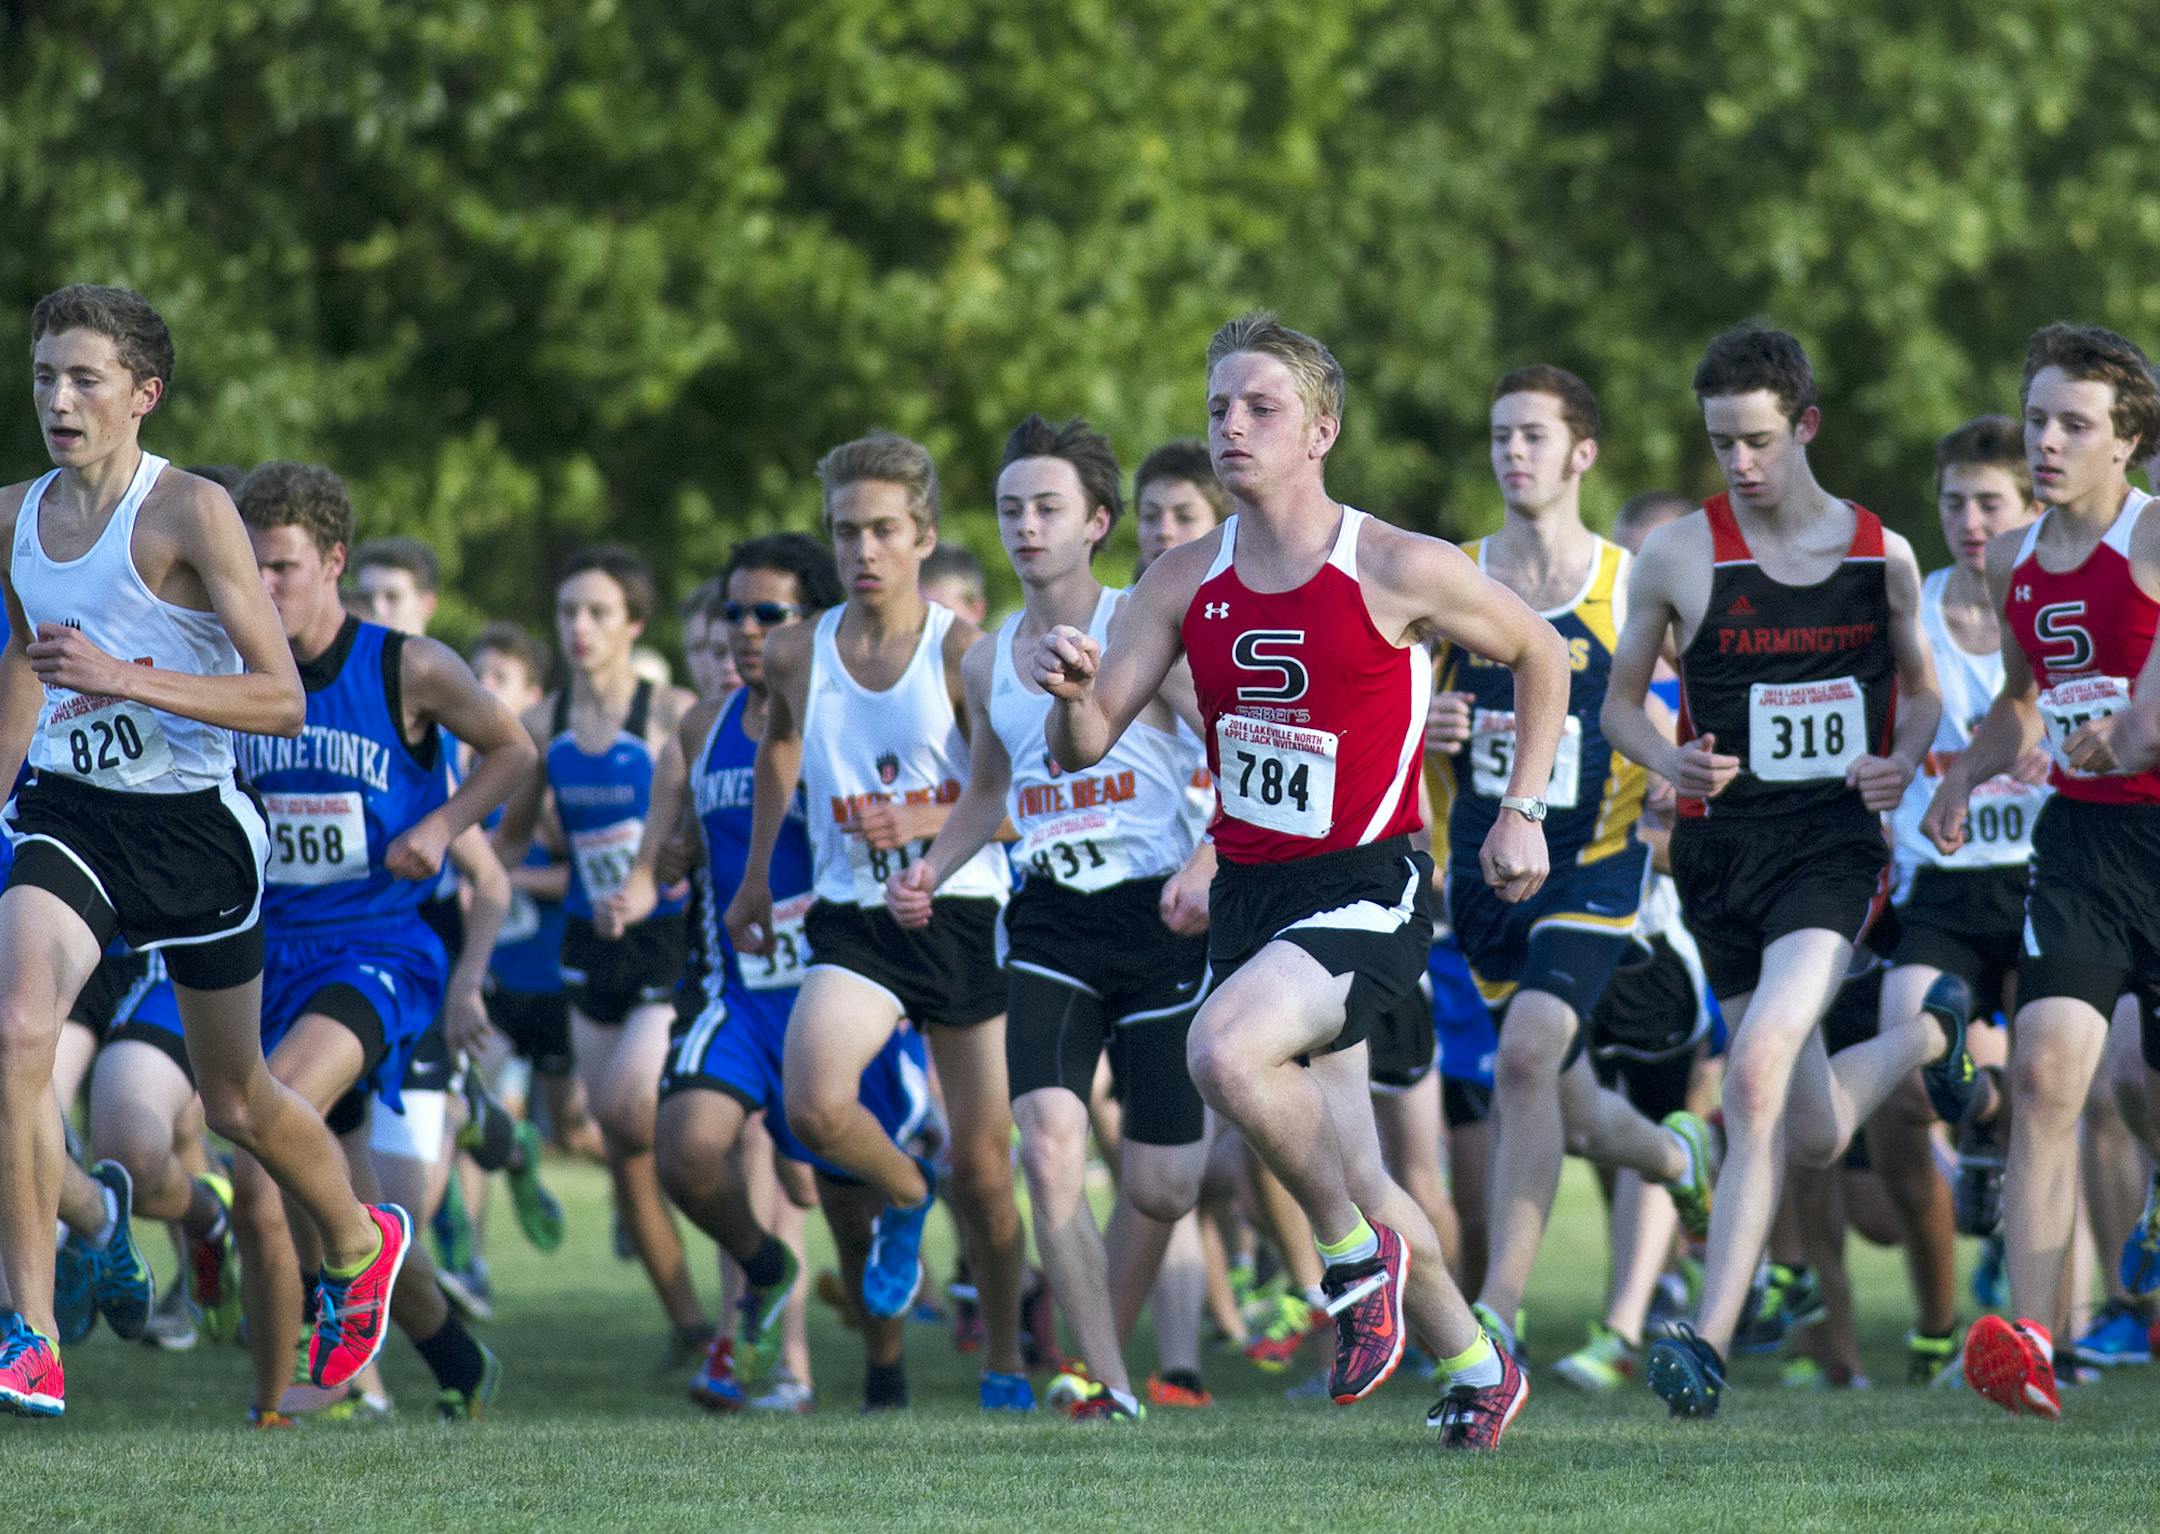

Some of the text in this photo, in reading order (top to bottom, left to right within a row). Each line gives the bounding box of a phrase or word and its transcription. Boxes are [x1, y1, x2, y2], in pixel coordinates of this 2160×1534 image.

[1717, 623, 1875, 655] FARMINGTON
[2035, 601, 2093, 669] S
[1232, 630, 1309, 702] S
[70, 714, 143, 775] 820
[1224, 728, 1326, 756] APPLE JACK INVITATIONAL
[1228, 719, 1323, 745] 2014 LAKEVILLE NORTH
[1771, 711, 1844, 760] 318
[1236, 750, 1309, 812] 784
[276, 823, 345, 865] 568
